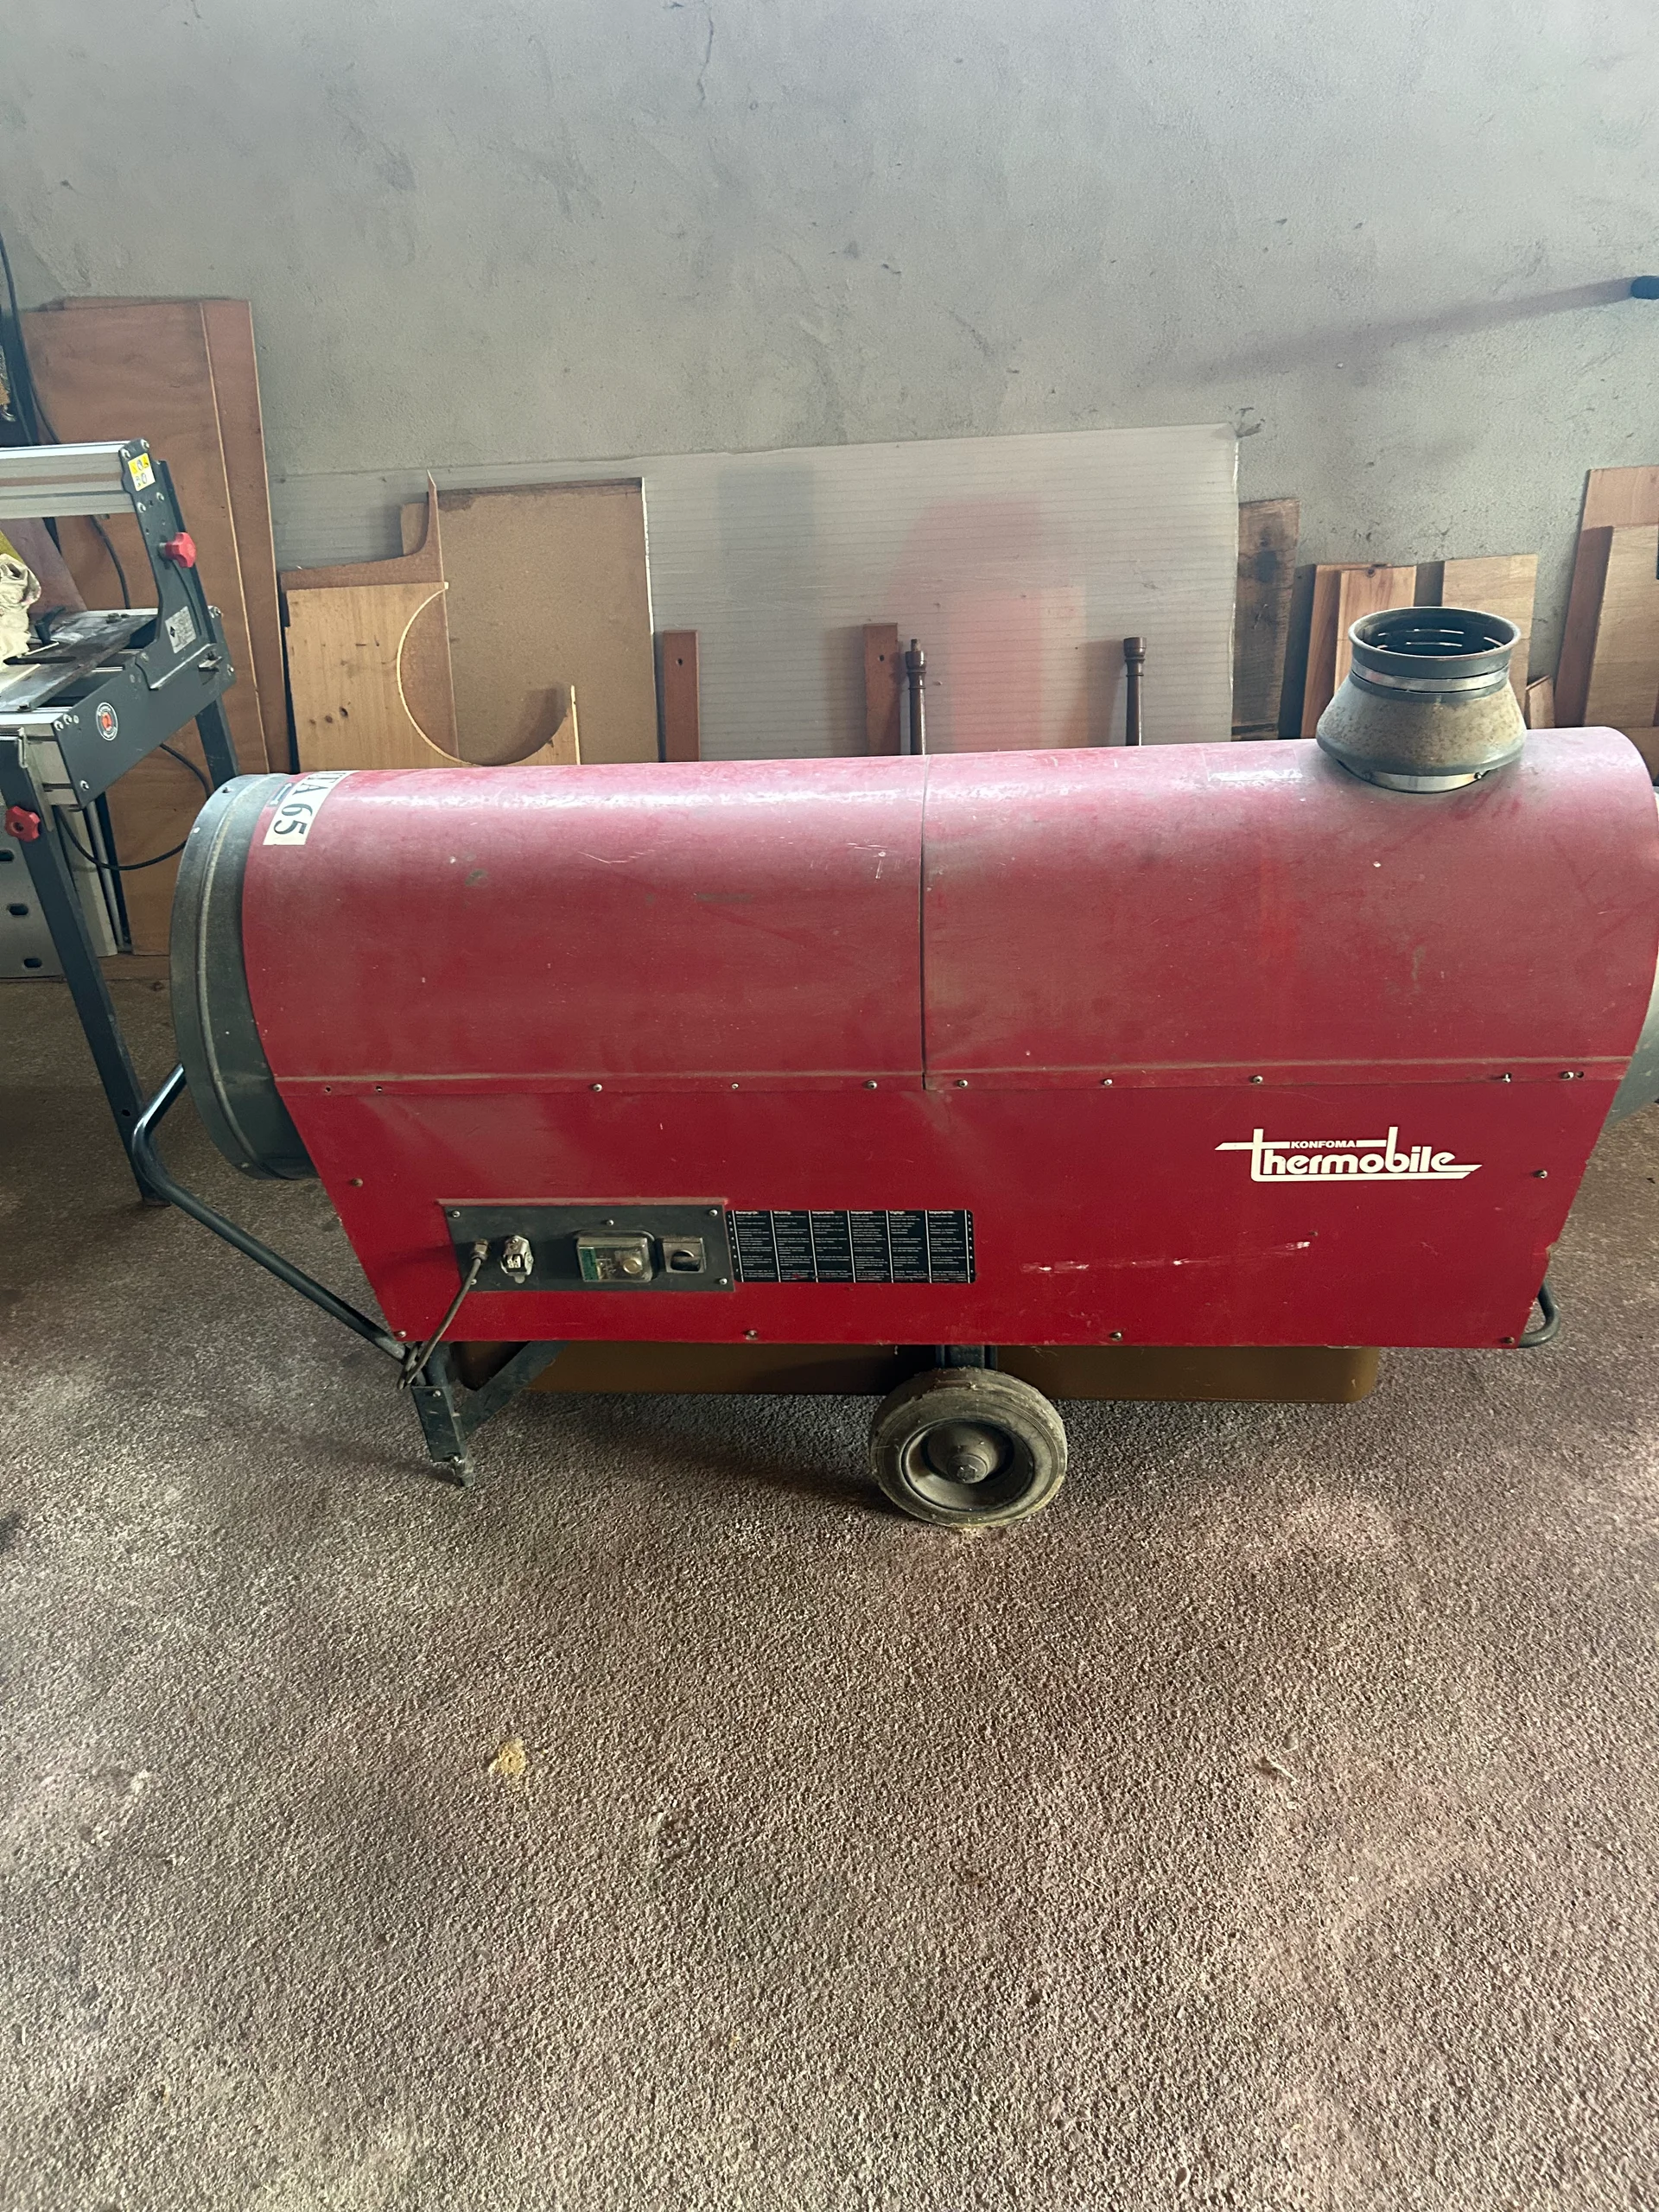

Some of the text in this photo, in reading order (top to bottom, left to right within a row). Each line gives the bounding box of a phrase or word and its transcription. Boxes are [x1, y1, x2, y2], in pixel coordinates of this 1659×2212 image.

[273, 803, 313, 835] 65
[1215, 1126, 1482, 1182] thermobile
[1291, 1140, 1357, 1149] KONFOMA
